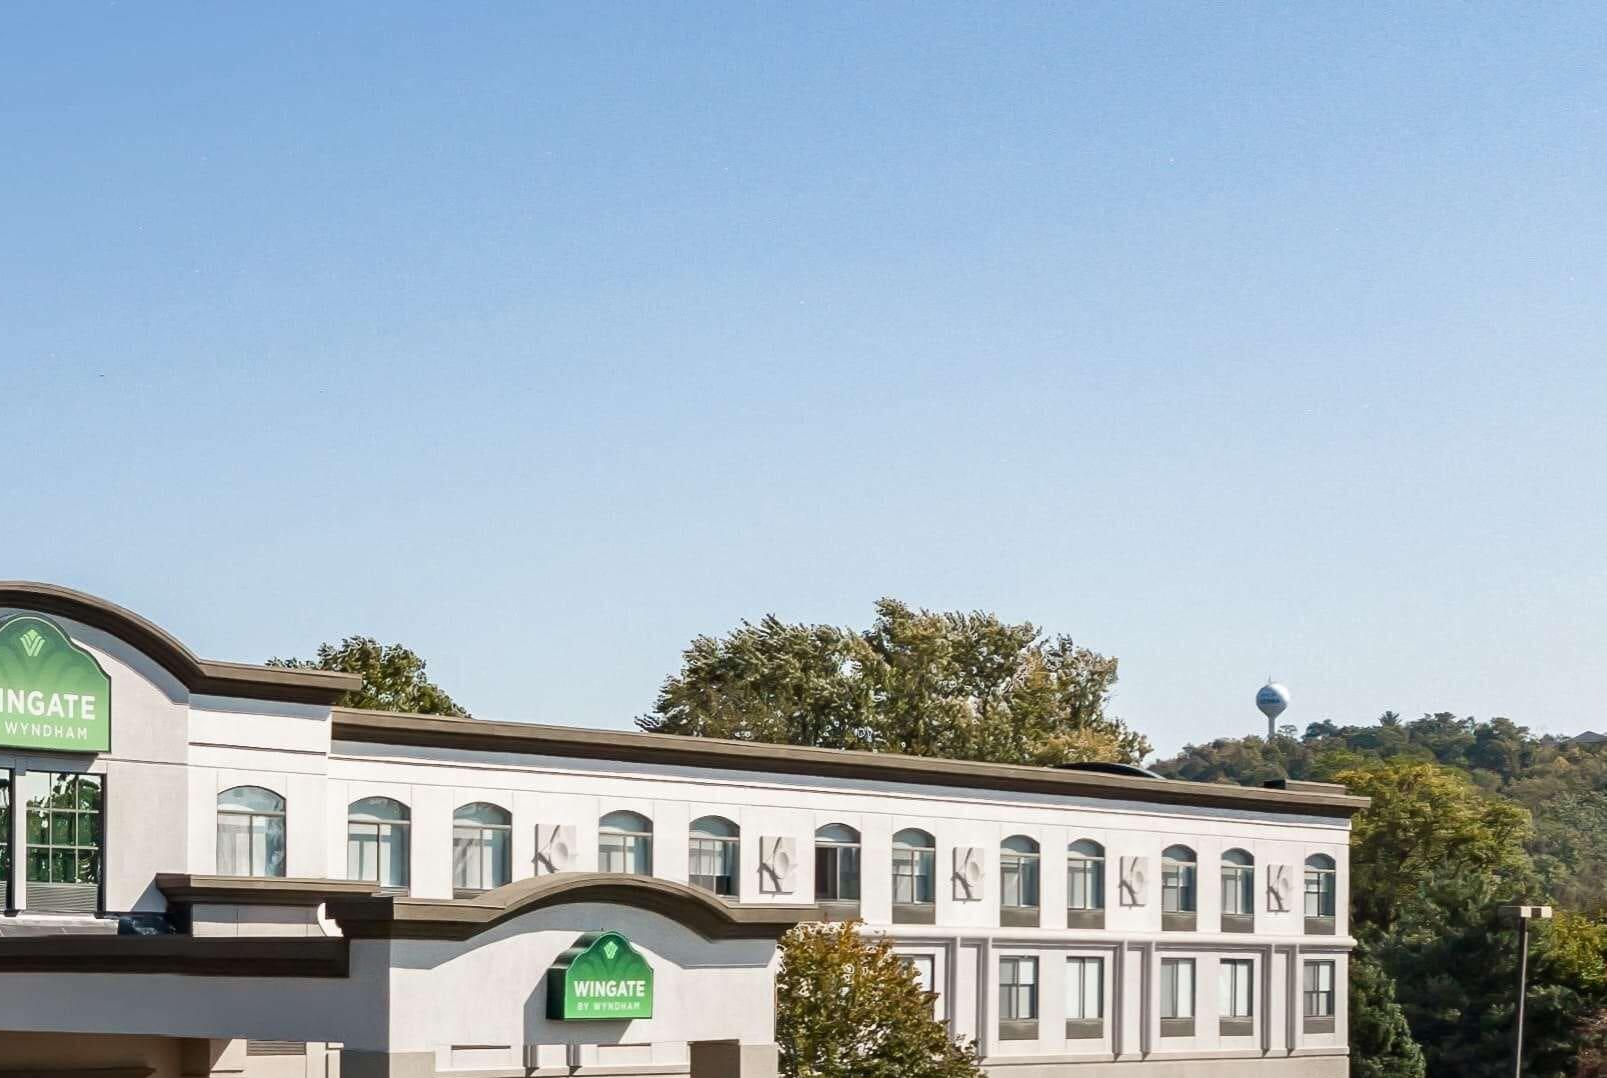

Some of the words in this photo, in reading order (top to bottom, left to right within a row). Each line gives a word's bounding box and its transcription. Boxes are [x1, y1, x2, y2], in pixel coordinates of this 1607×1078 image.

[4, 721, 88, 740] WYNDHAM
[574, 980, 646, 997] WINGATE
[576, 1002, 589, 1011] BY
[594, 1001, 641, 1011] WYNDHAM
